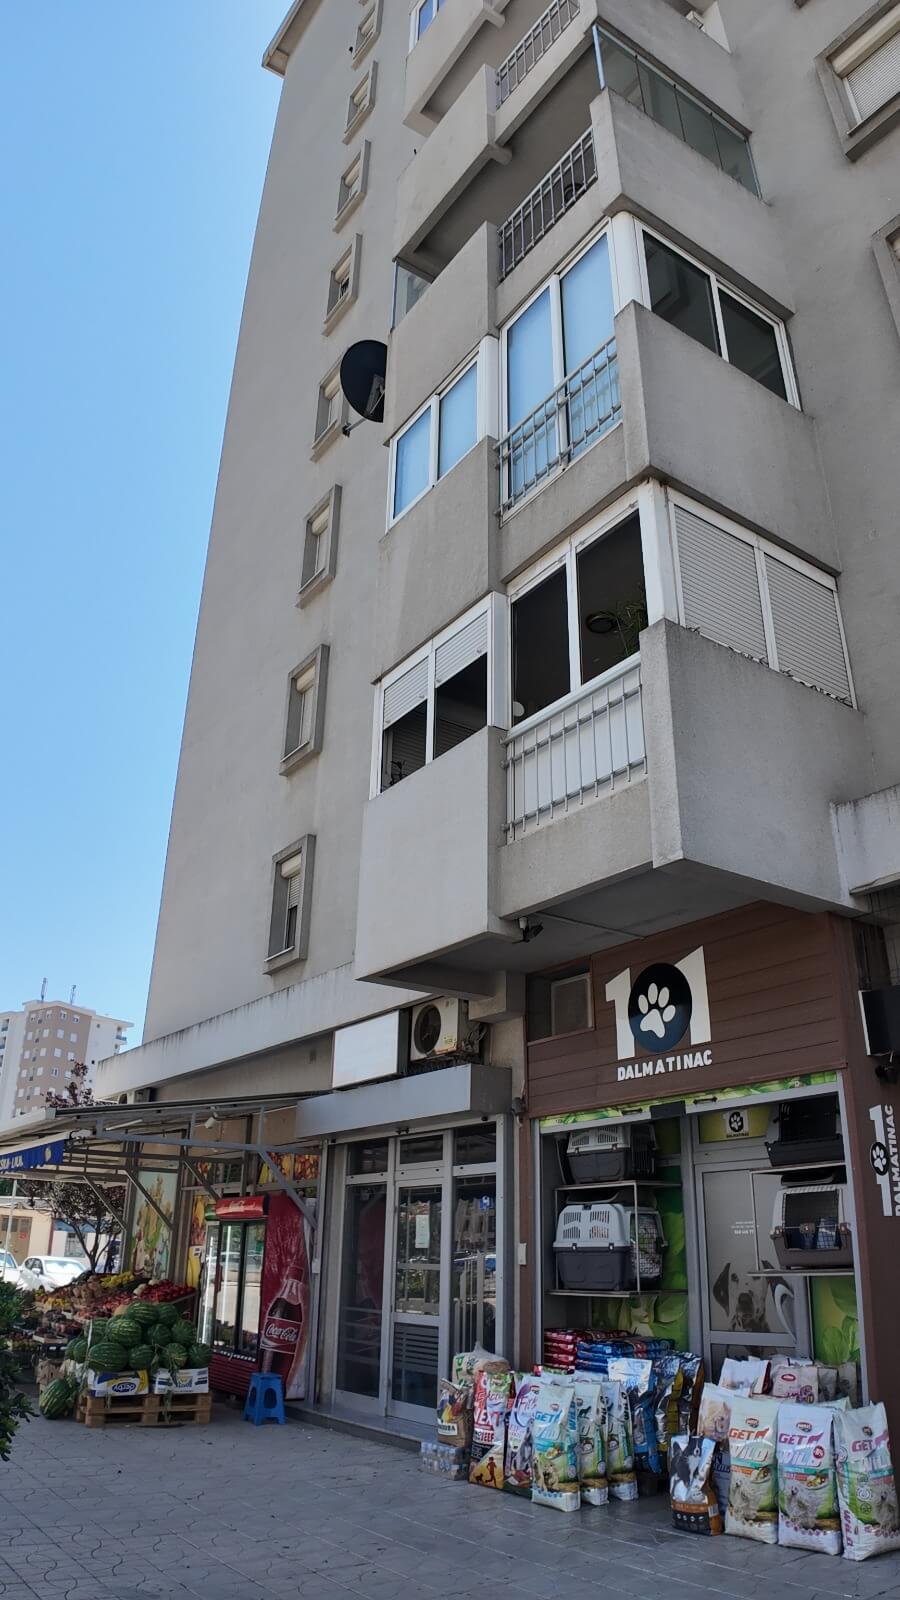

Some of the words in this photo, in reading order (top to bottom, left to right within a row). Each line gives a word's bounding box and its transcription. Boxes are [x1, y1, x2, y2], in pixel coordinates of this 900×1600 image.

[616, 1049, 713, 1082] DALMATINAC
[728, 1428, 755, 1441] GET
[779, 1433, 808, 1446] GET
[851, 1439, 874, 1453] GET
